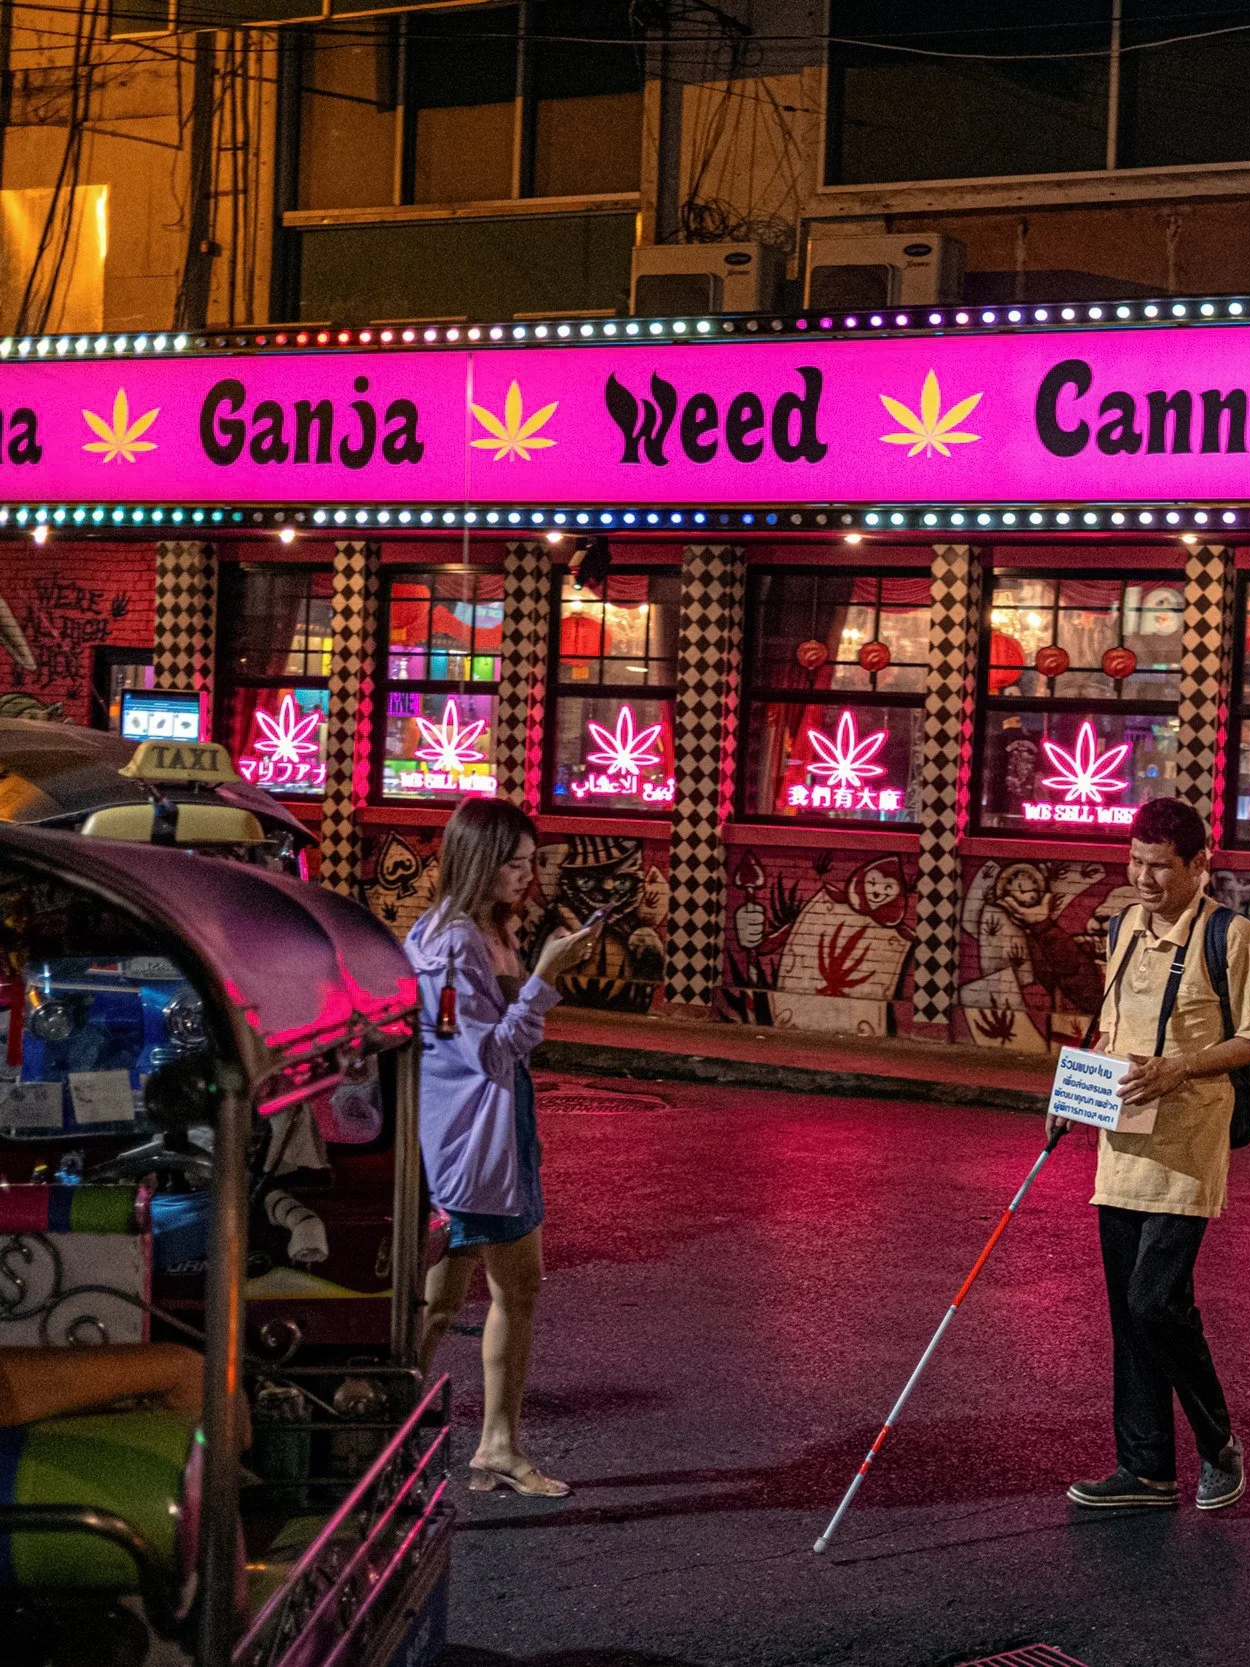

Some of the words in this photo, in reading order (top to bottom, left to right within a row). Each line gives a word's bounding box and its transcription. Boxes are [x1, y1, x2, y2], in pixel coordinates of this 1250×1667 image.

[0, 407, 43, 466] a
[200, 375, 425, 470] Ganja
[605, 366, 828, 467] Weed
[151, 745, 218, 772] TAXI
[1022, 803, 1052, 821] WE
[1053, 805, 1094, 823] SELL
[1096, 806, 1138, 825] WEE
